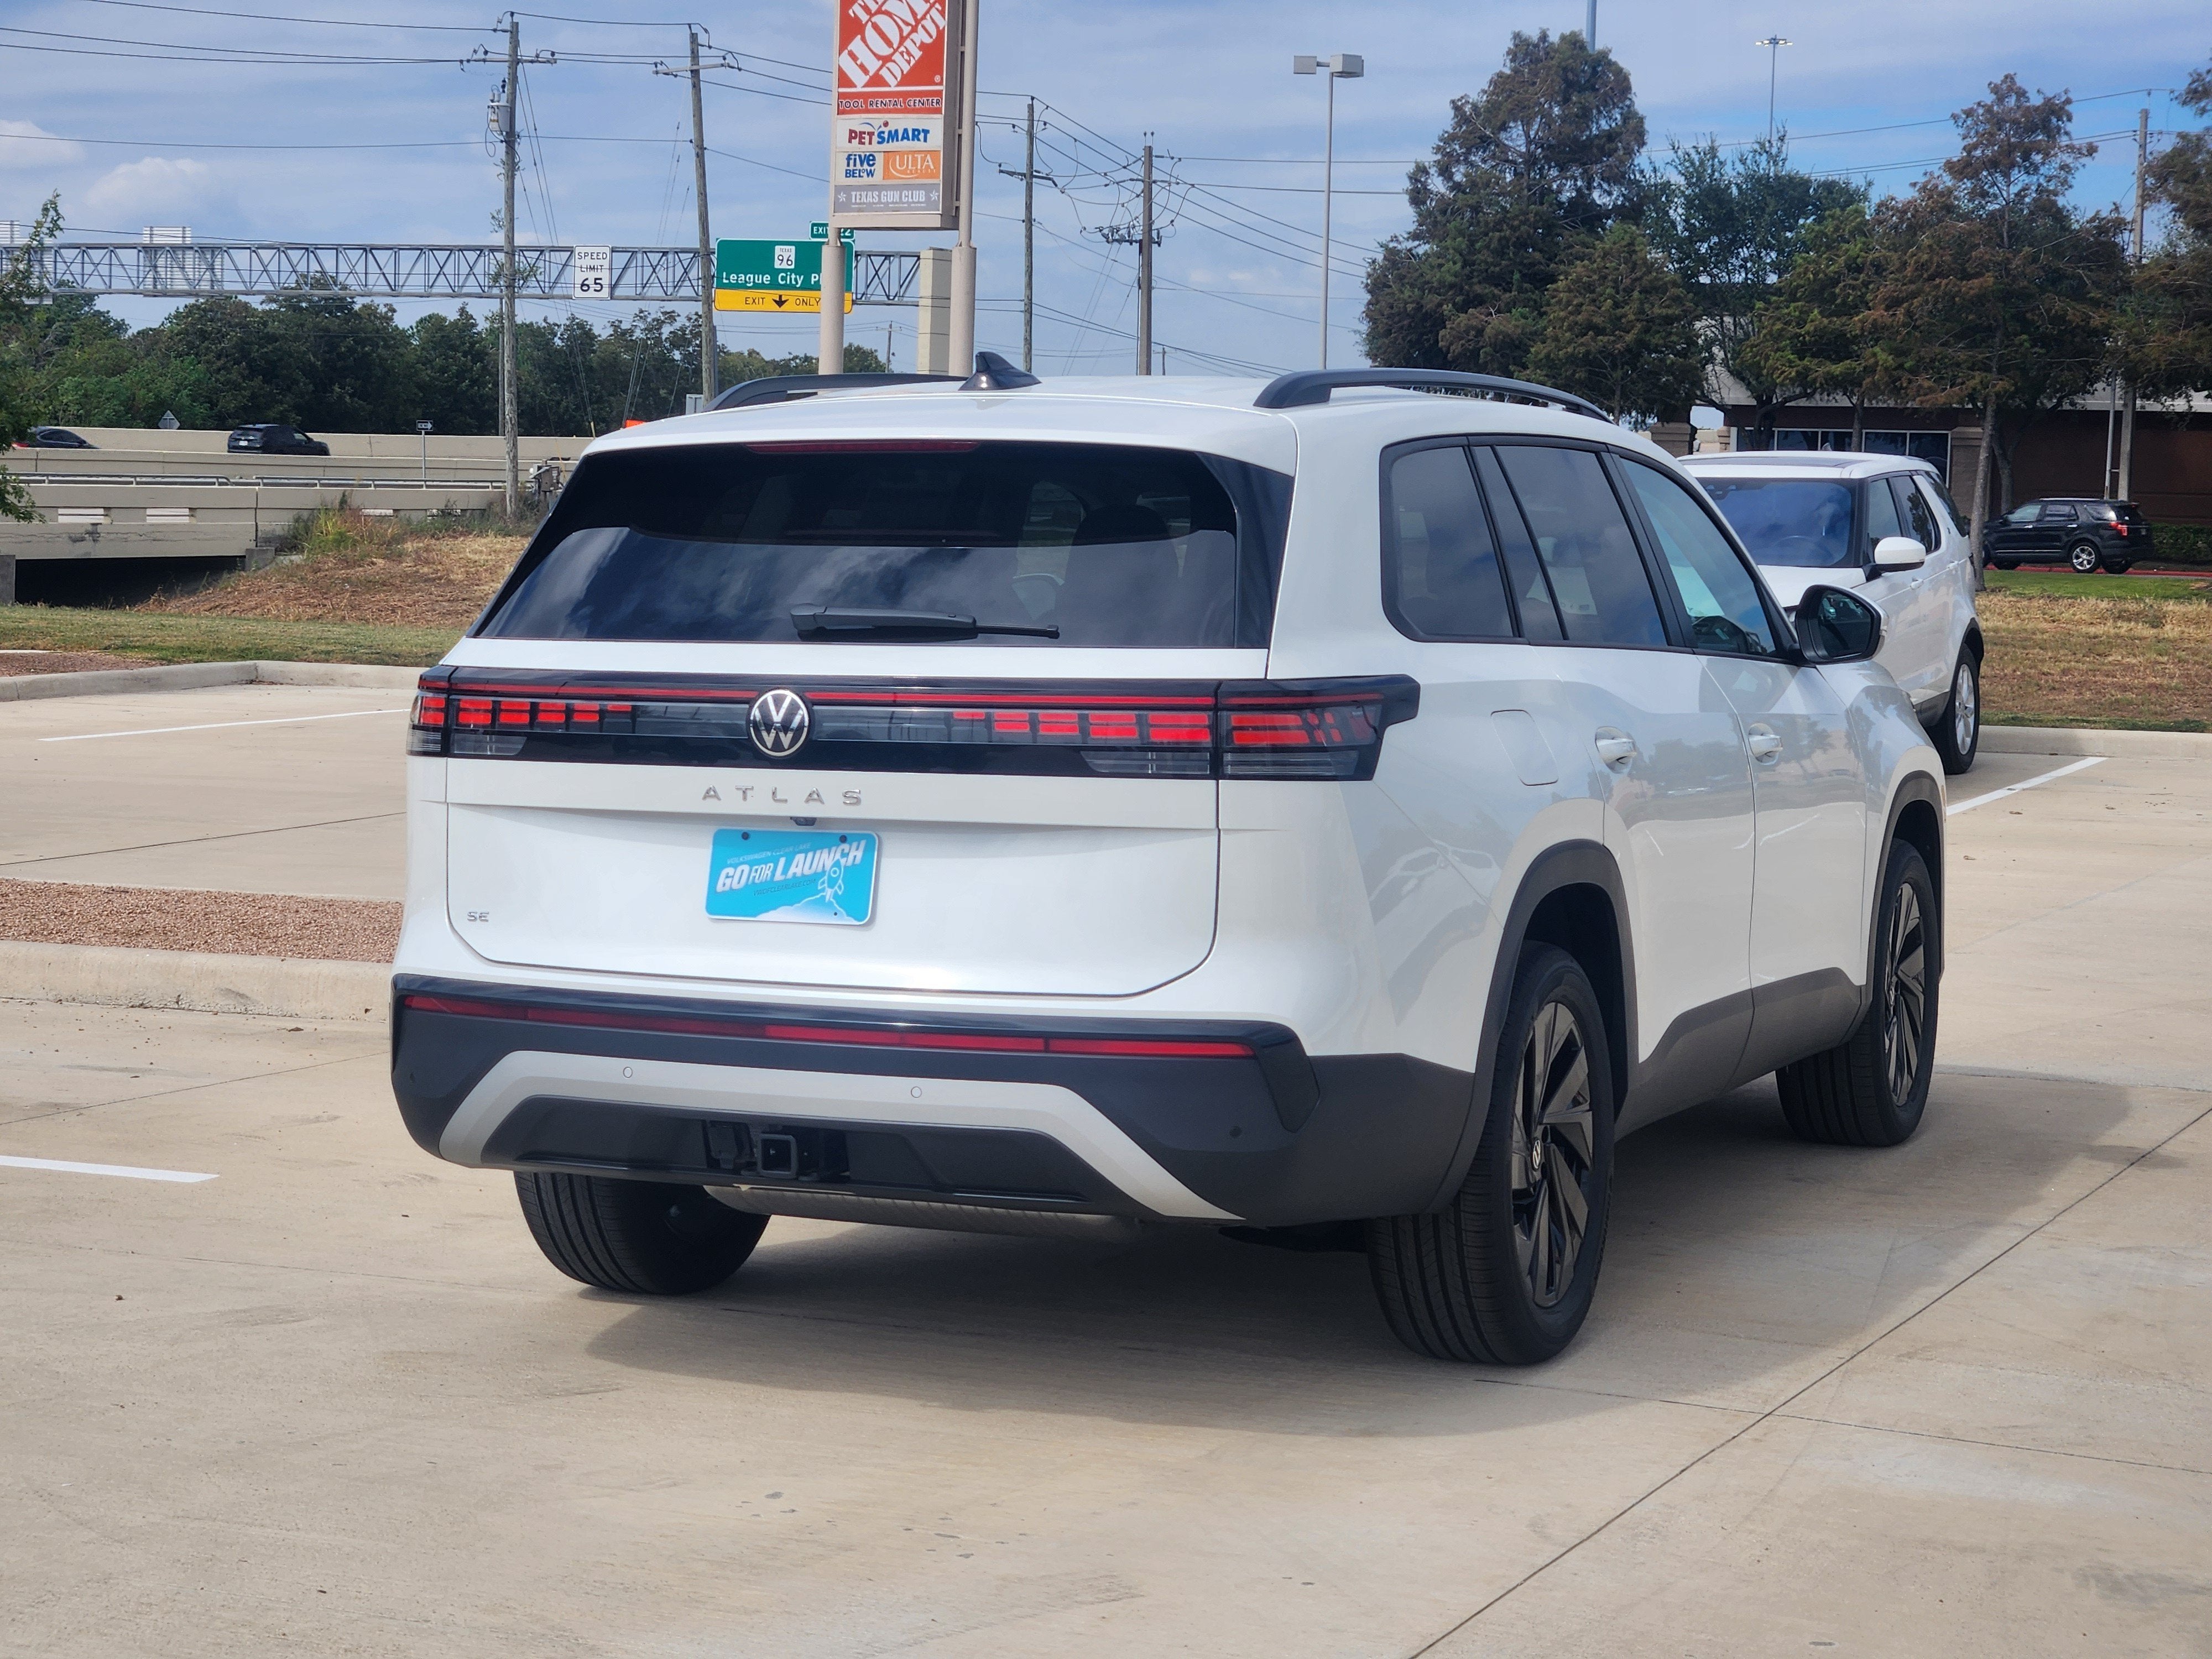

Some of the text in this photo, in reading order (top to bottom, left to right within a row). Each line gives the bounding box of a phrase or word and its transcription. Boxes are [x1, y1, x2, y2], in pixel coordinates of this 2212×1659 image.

[839, 0, 934, 88] HOM
[879, 3, 946, 88] DEPOT
[839, 98, 941, 108] TOOL RENTAL CENTER
[846, 154, 876, 168] five
[896, 154, 934, 169] ULTA
[851, 190, 925, 202] TEXAS GUN CLUB
[778, 254, 793, 266] 96
[580, 264, 604, 273] LIMIT
[580, 278, 603, 292] 65
[723, 272, 771, 286] League
[778, 272, 804, 288] City
[744, 297, 821, 306] EXIT ONLY
[702, 785, 862, 806] ATLAS
[716, 839, 866, 892] GO FOR LAUNCH
[467, 911, 489, 922] SE
